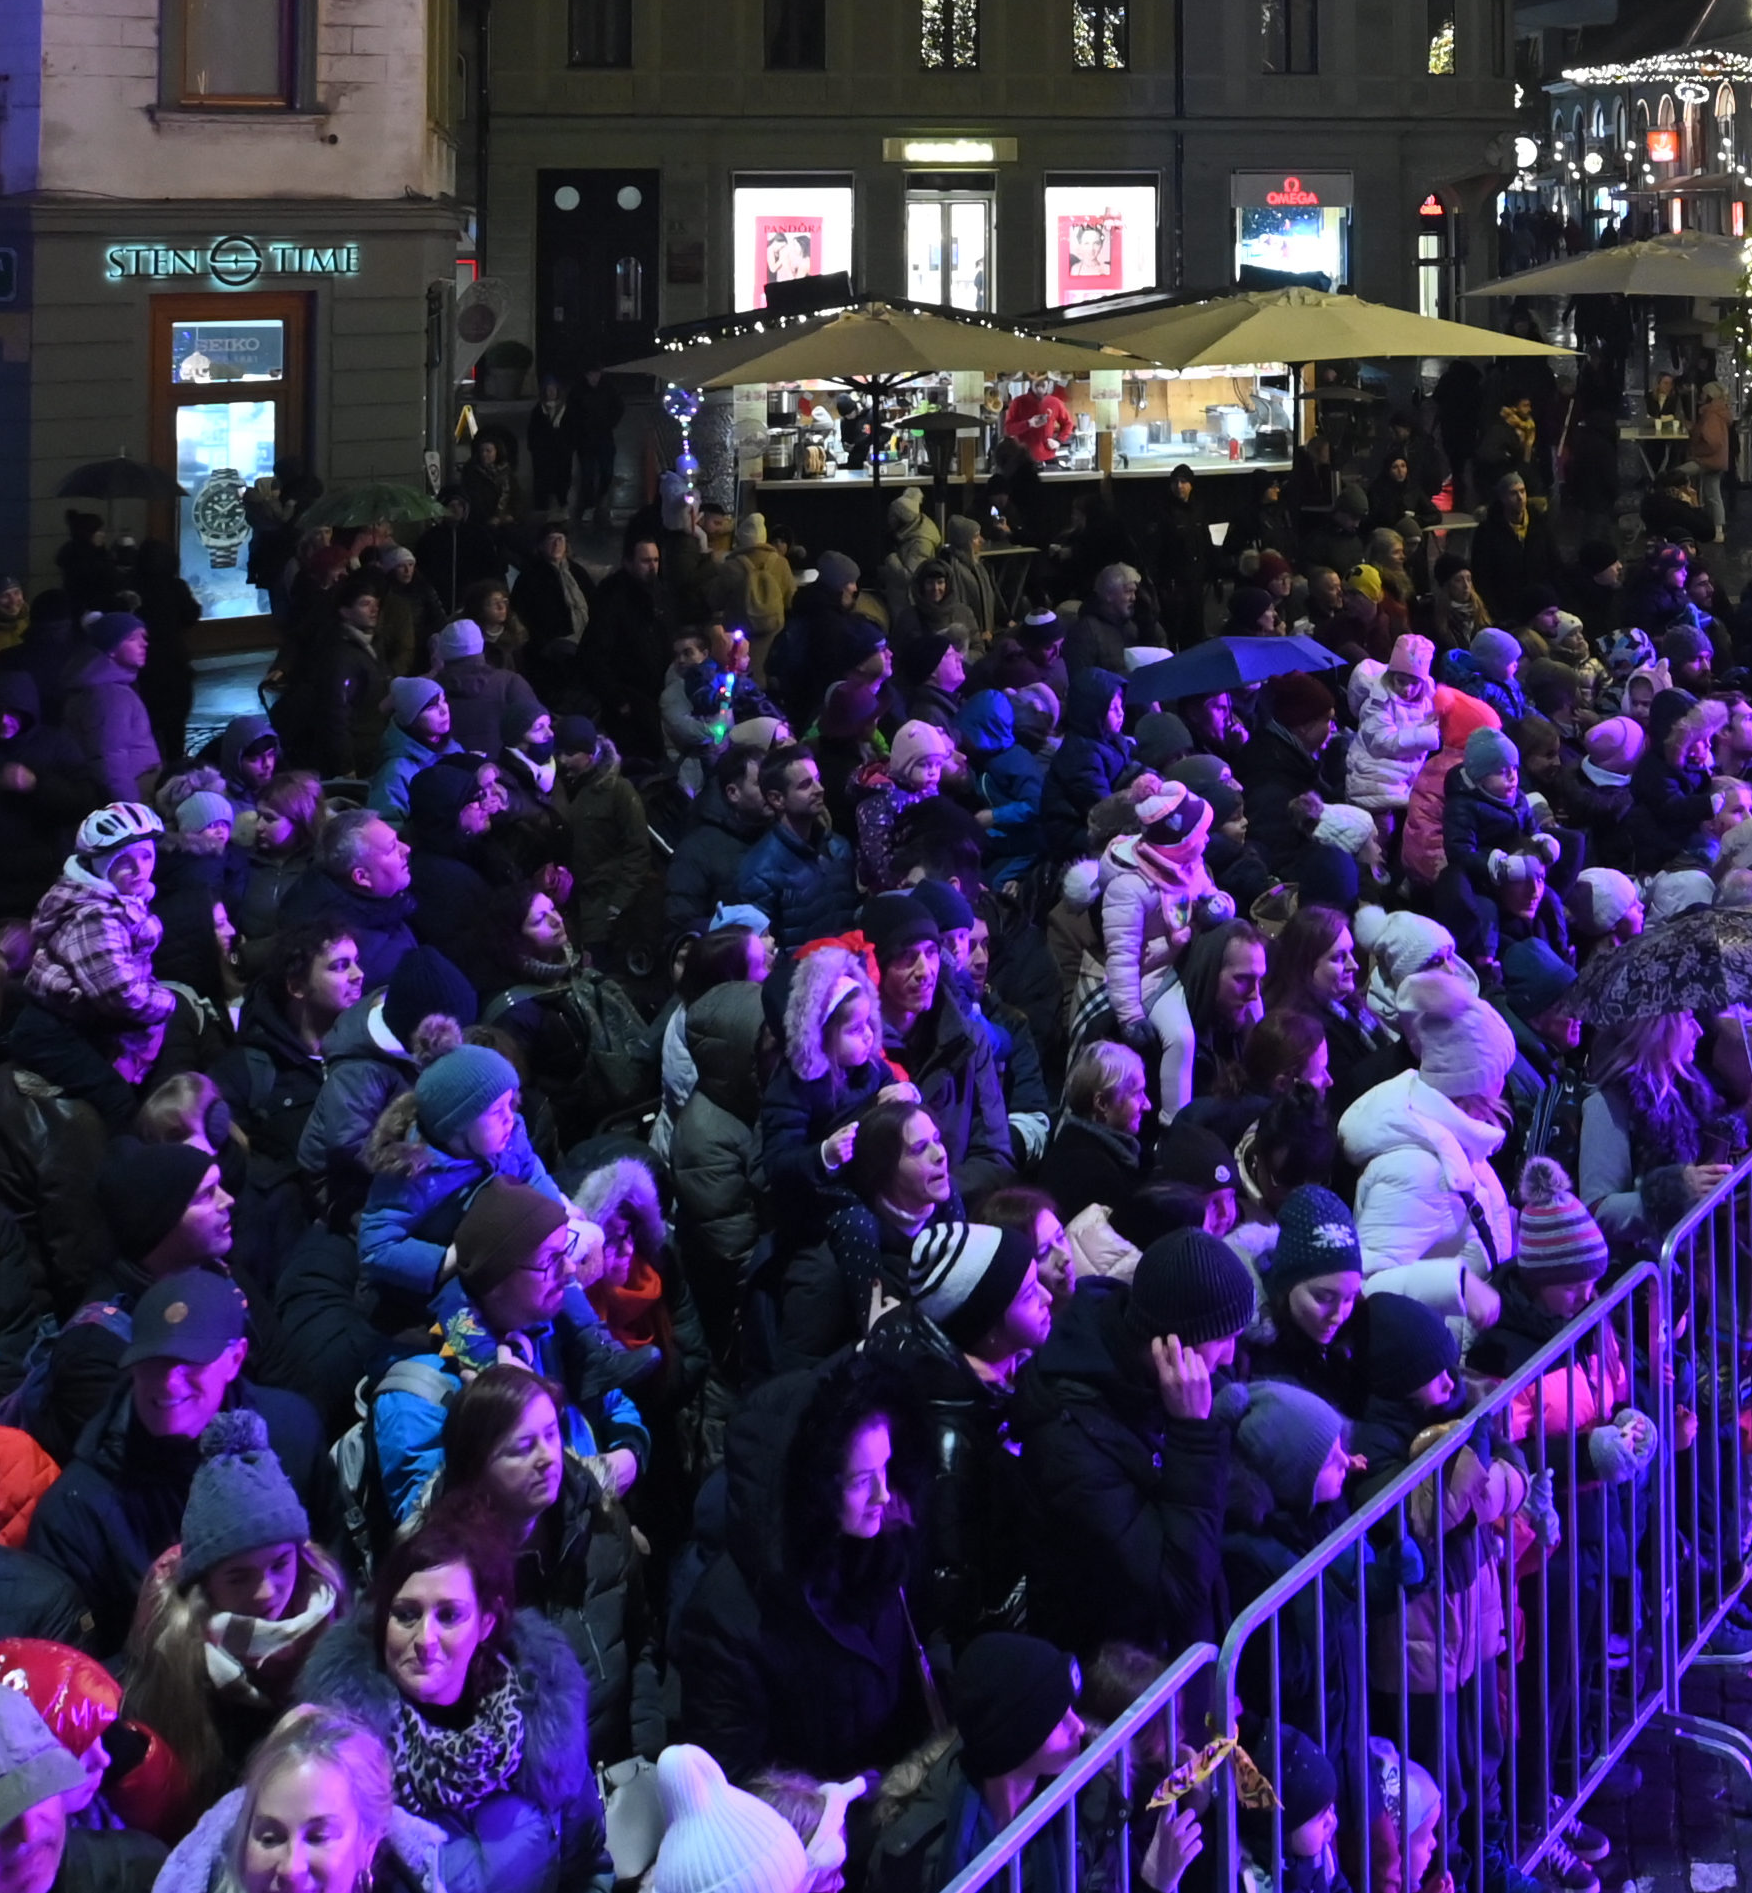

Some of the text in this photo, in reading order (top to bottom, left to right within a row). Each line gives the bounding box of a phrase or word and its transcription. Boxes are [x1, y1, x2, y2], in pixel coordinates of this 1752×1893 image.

[1266, 191, 1319, 205] OMEGA
[108, 246, 360, 277] STEN TIME
[196, 337, 260, 352] SEIKO
